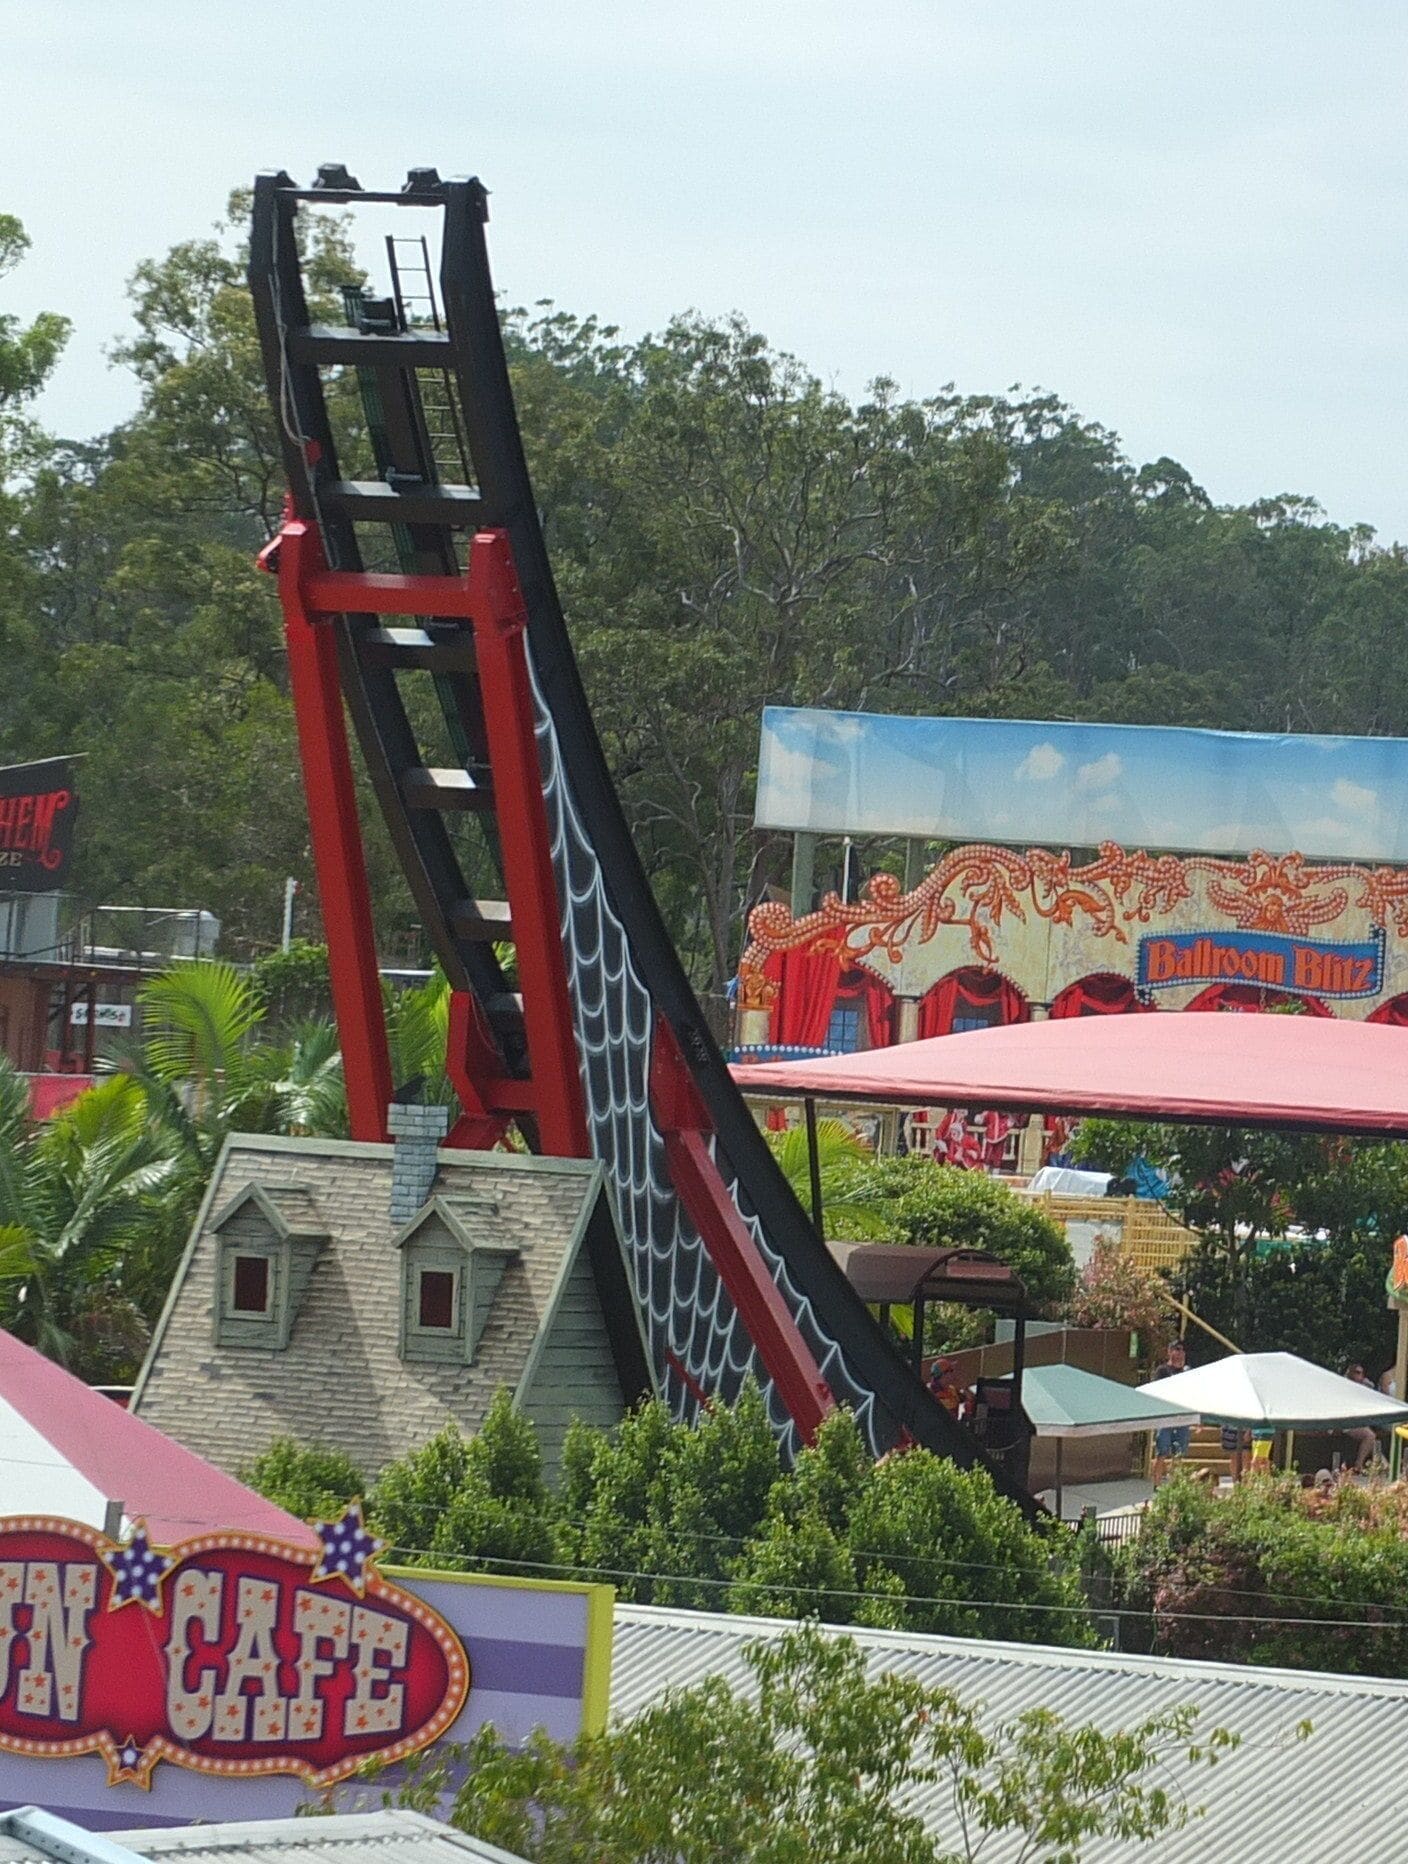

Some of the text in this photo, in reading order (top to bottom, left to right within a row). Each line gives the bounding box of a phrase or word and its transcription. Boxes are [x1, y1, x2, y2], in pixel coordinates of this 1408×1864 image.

[1147, 938, 1374, 991] Ballroom Blitz
[166, 1568, 409, 1741] CAFE
